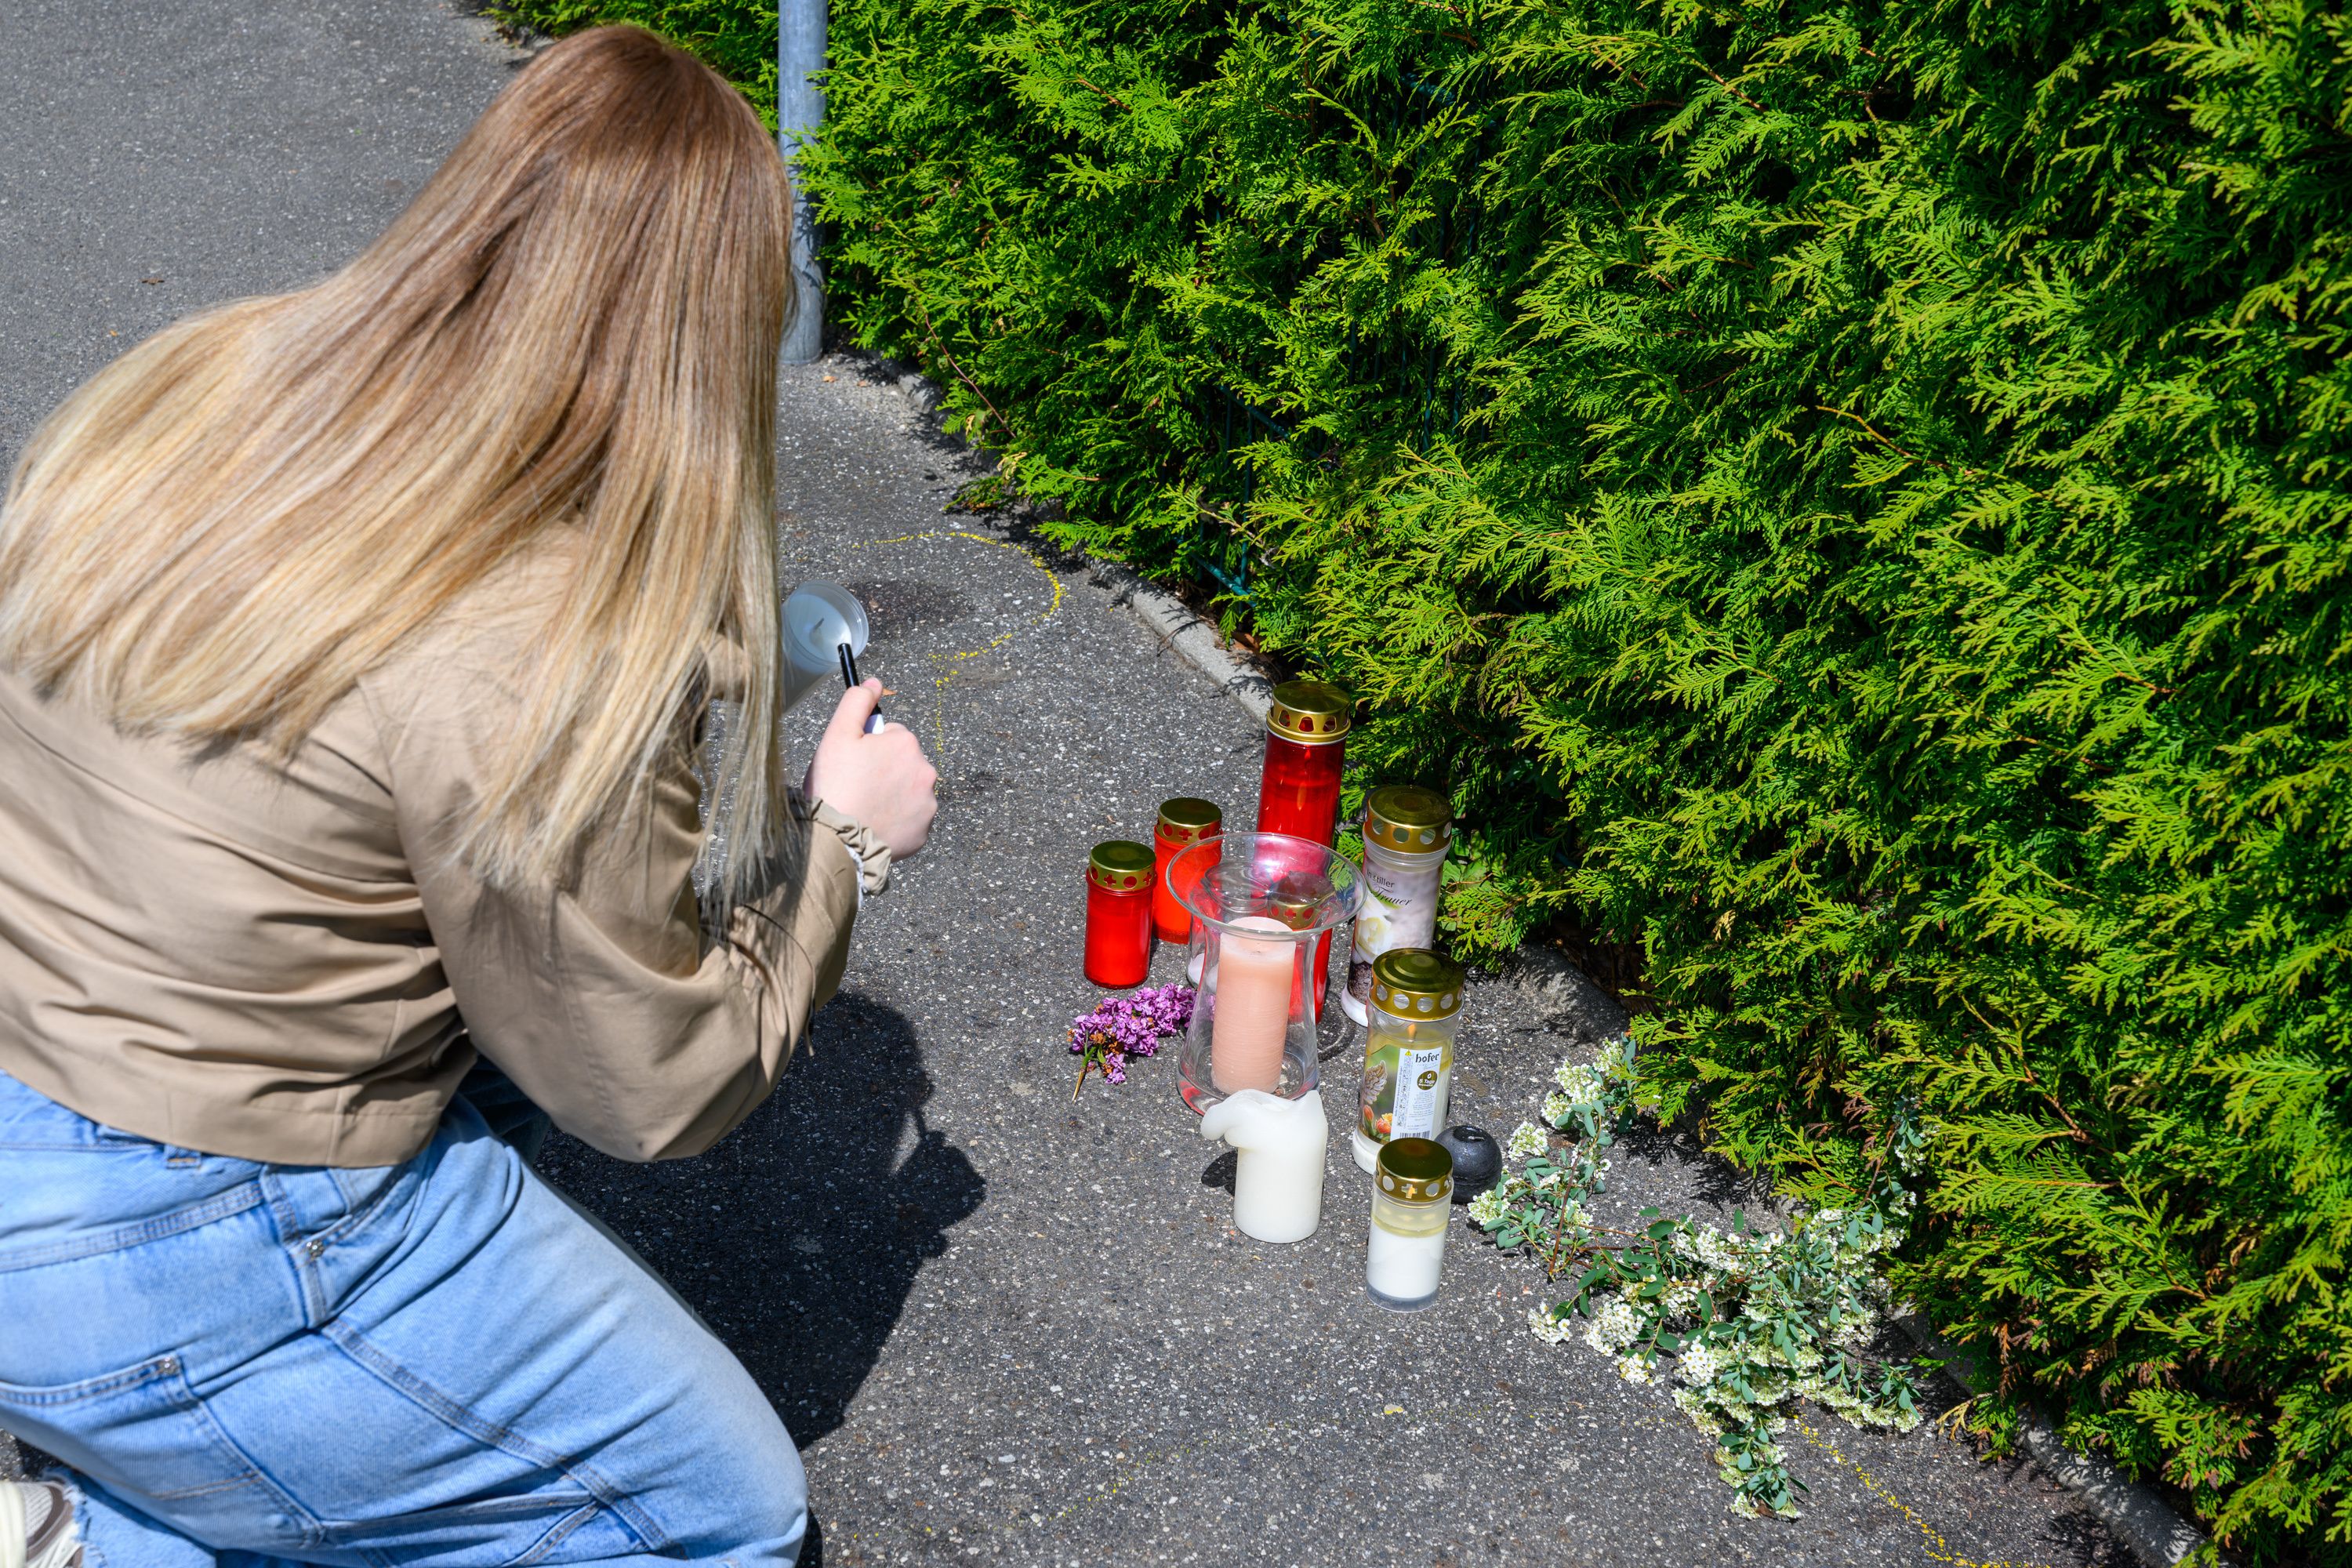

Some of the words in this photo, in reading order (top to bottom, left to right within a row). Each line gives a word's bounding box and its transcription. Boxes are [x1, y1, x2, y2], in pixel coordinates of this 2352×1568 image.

[1373, 875, 1395, 887] stiller
[1374, 886, 1412, 906] Trauer
[1415, 1052, 1439, 1063] hofer
